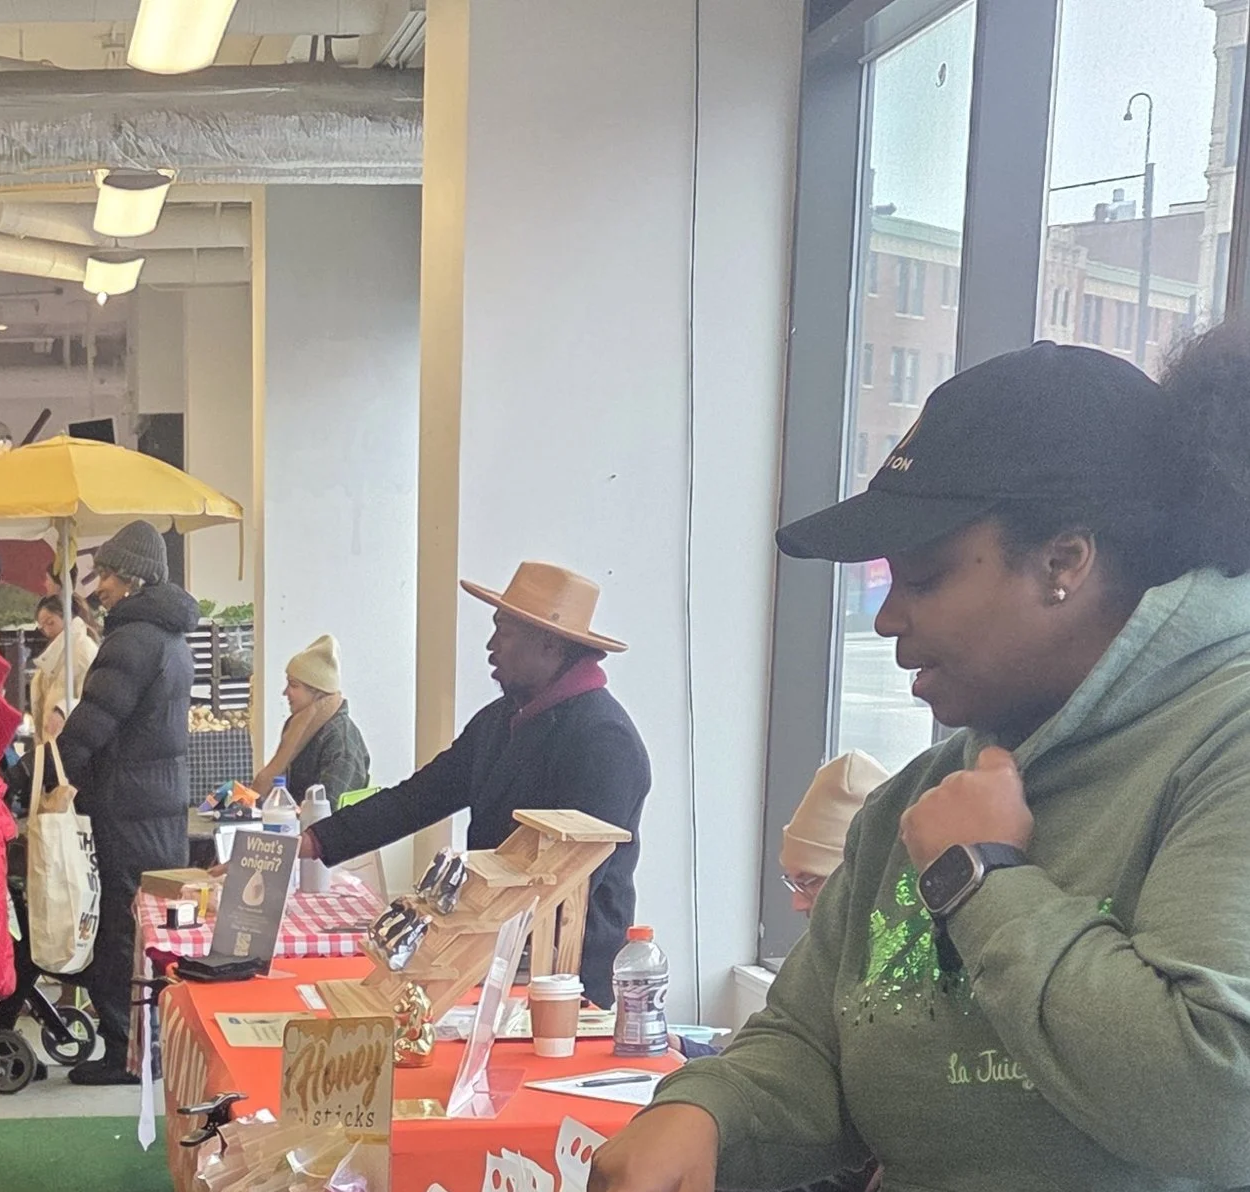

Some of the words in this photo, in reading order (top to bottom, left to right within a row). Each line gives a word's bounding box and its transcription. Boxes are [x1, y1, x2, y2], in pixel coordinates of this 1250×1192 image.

[246, 836, 284, 855] What's
[283, 1040, 388, 1122] Honey
[947, 1052, 971, 1084] La
[312, 1103, 376, 1128] sticks
